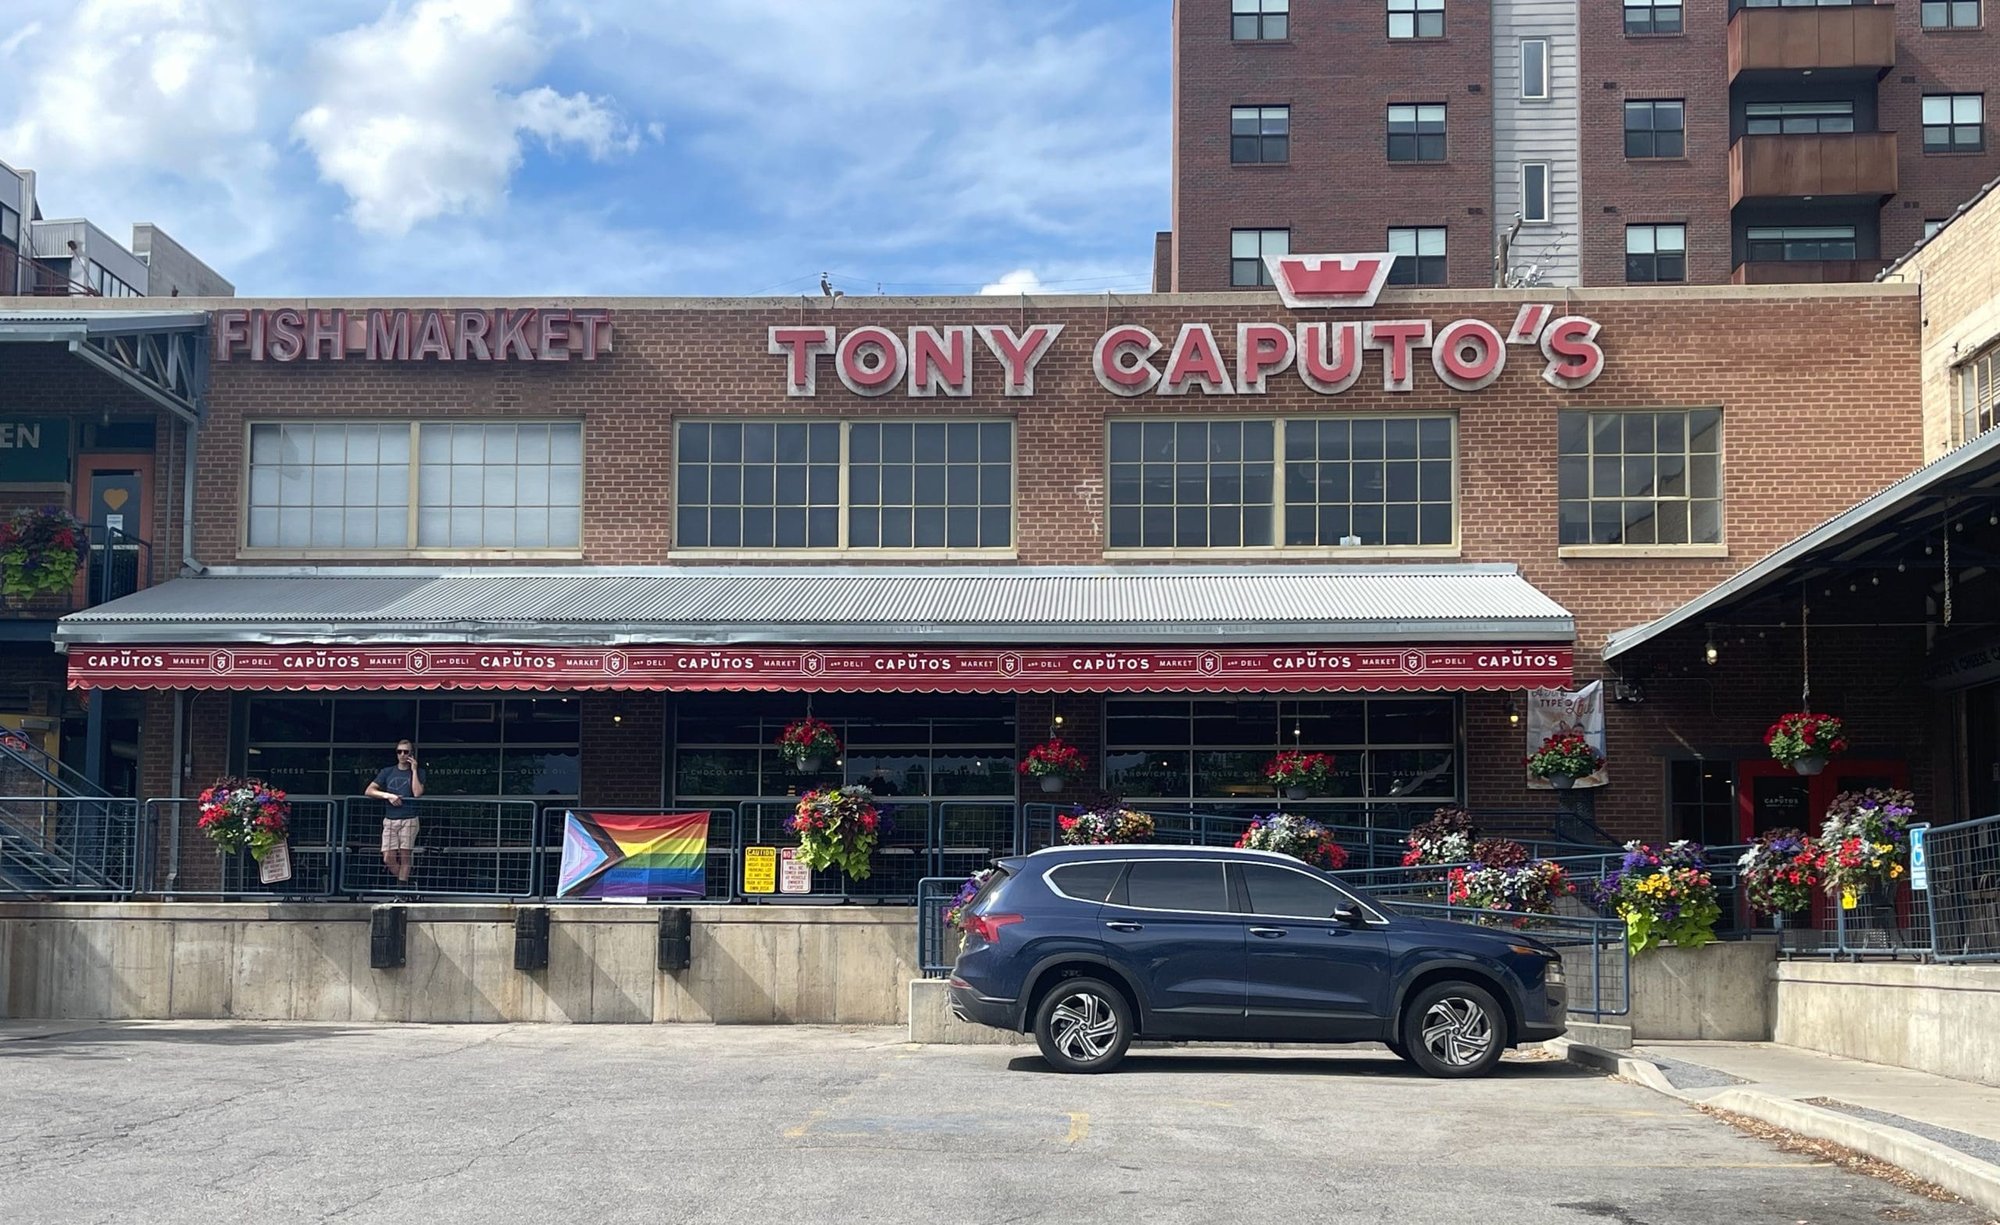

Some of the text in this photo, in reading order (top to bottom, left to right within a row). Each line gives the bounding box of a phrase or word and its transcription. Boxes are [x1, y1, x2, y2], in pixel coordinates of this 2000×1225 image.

[217, 307, 611, 362] FISH MARKET
[769, 304, 1603, 395] TONY CAPUTO'S
[87, 655, 164, 667] CAPUTO'S
[172, 657, 205, 665] MARKET
[283, 656, 360, 668] CAPUTO'S
[369, 657, 402, 665] MARKET
[480, 655, 556, 669] CAPUTO'S
[566, 659, 600, 667] MARKET
[677, 657, 754, 669] CAPUTO'S
[874, 658, 952, 670] CAPUTO'S
[960, 660, 993, 668] MARKET
[1072, 658, 1150, 670] CAPUTO'S
[1272, 656, 1352, 669] CAPUTO'S
[1477, 655, 1558, 667] CAPUTO'S
